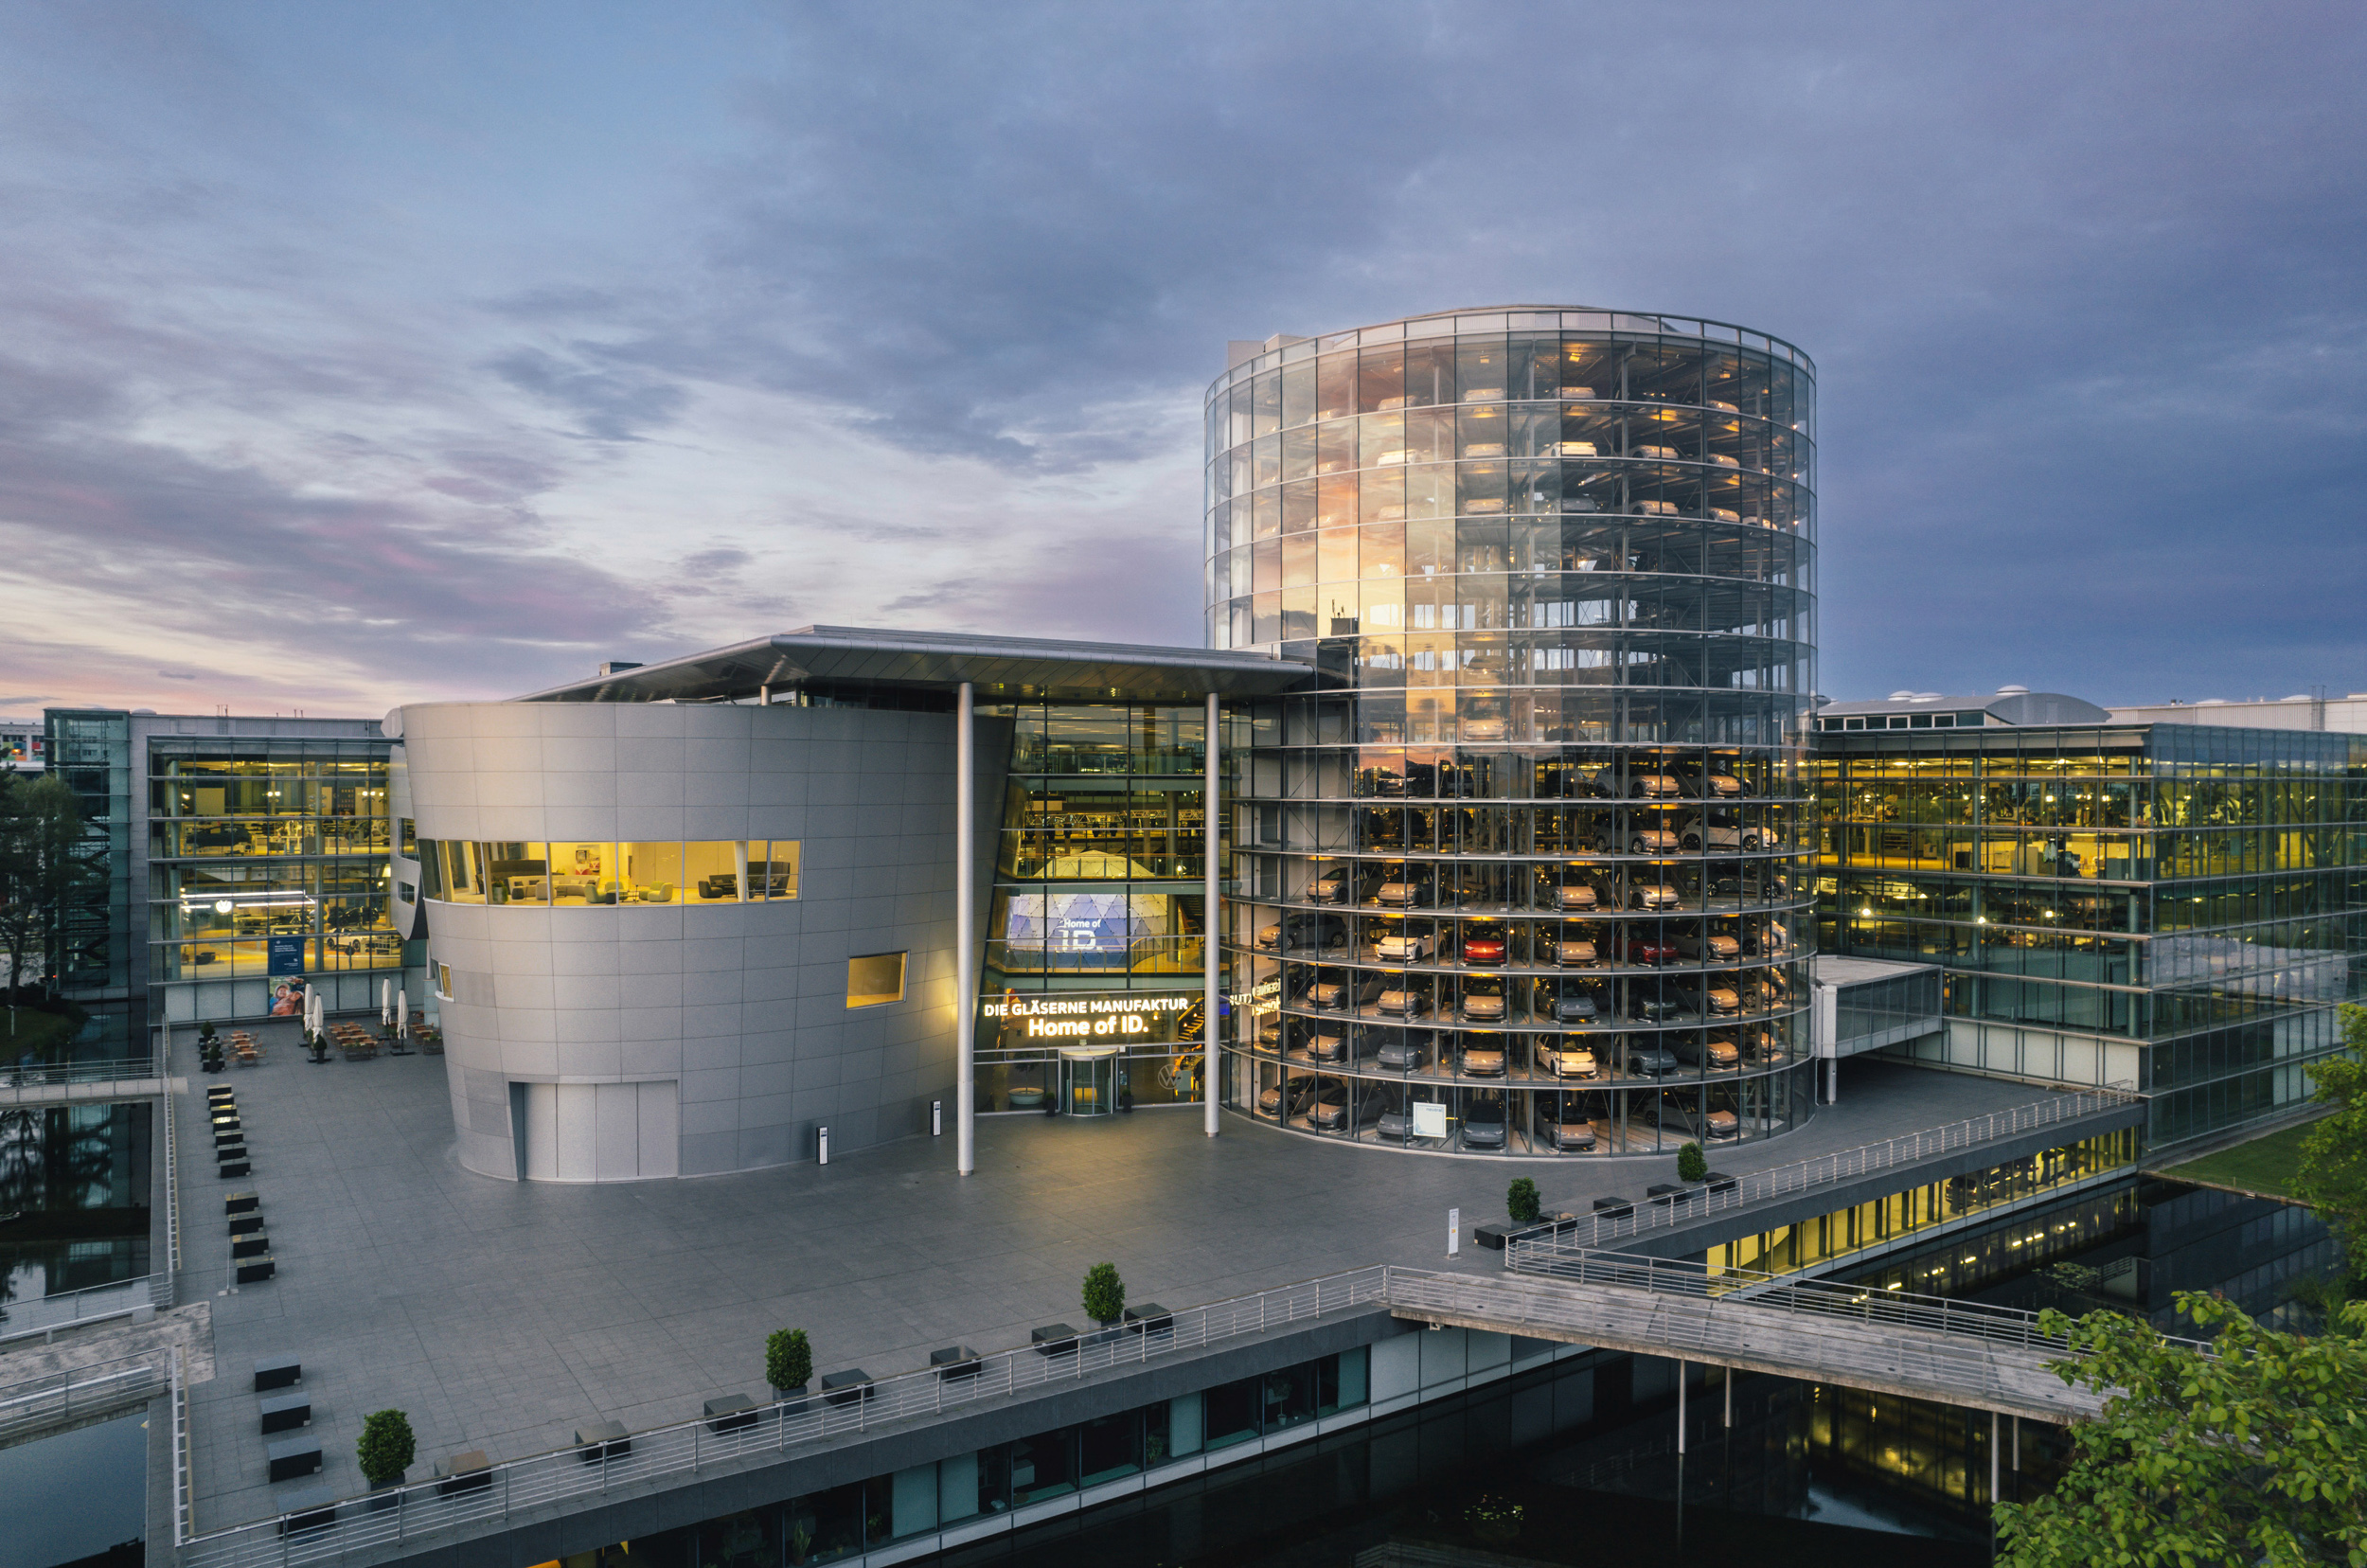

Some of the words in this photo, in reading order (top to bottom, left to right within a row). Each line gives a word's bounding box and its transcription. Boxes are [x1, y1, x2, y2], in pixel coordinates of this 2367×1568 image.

[1063, 918, 1091, 928] Home
[1092, 918, 1102, 928] of
[985, 1004, 1008, 1017] DIE
[1011, 1000, 1087, 1015] GLÄSERNE
[1090, 997, 1188, 1013] MANUFAKTUR
[1028, 1018, 1091, 1037] Home
[1095, 1015, 1117, 1035] of
[1121, 1015, 1149, 1034] ID.
